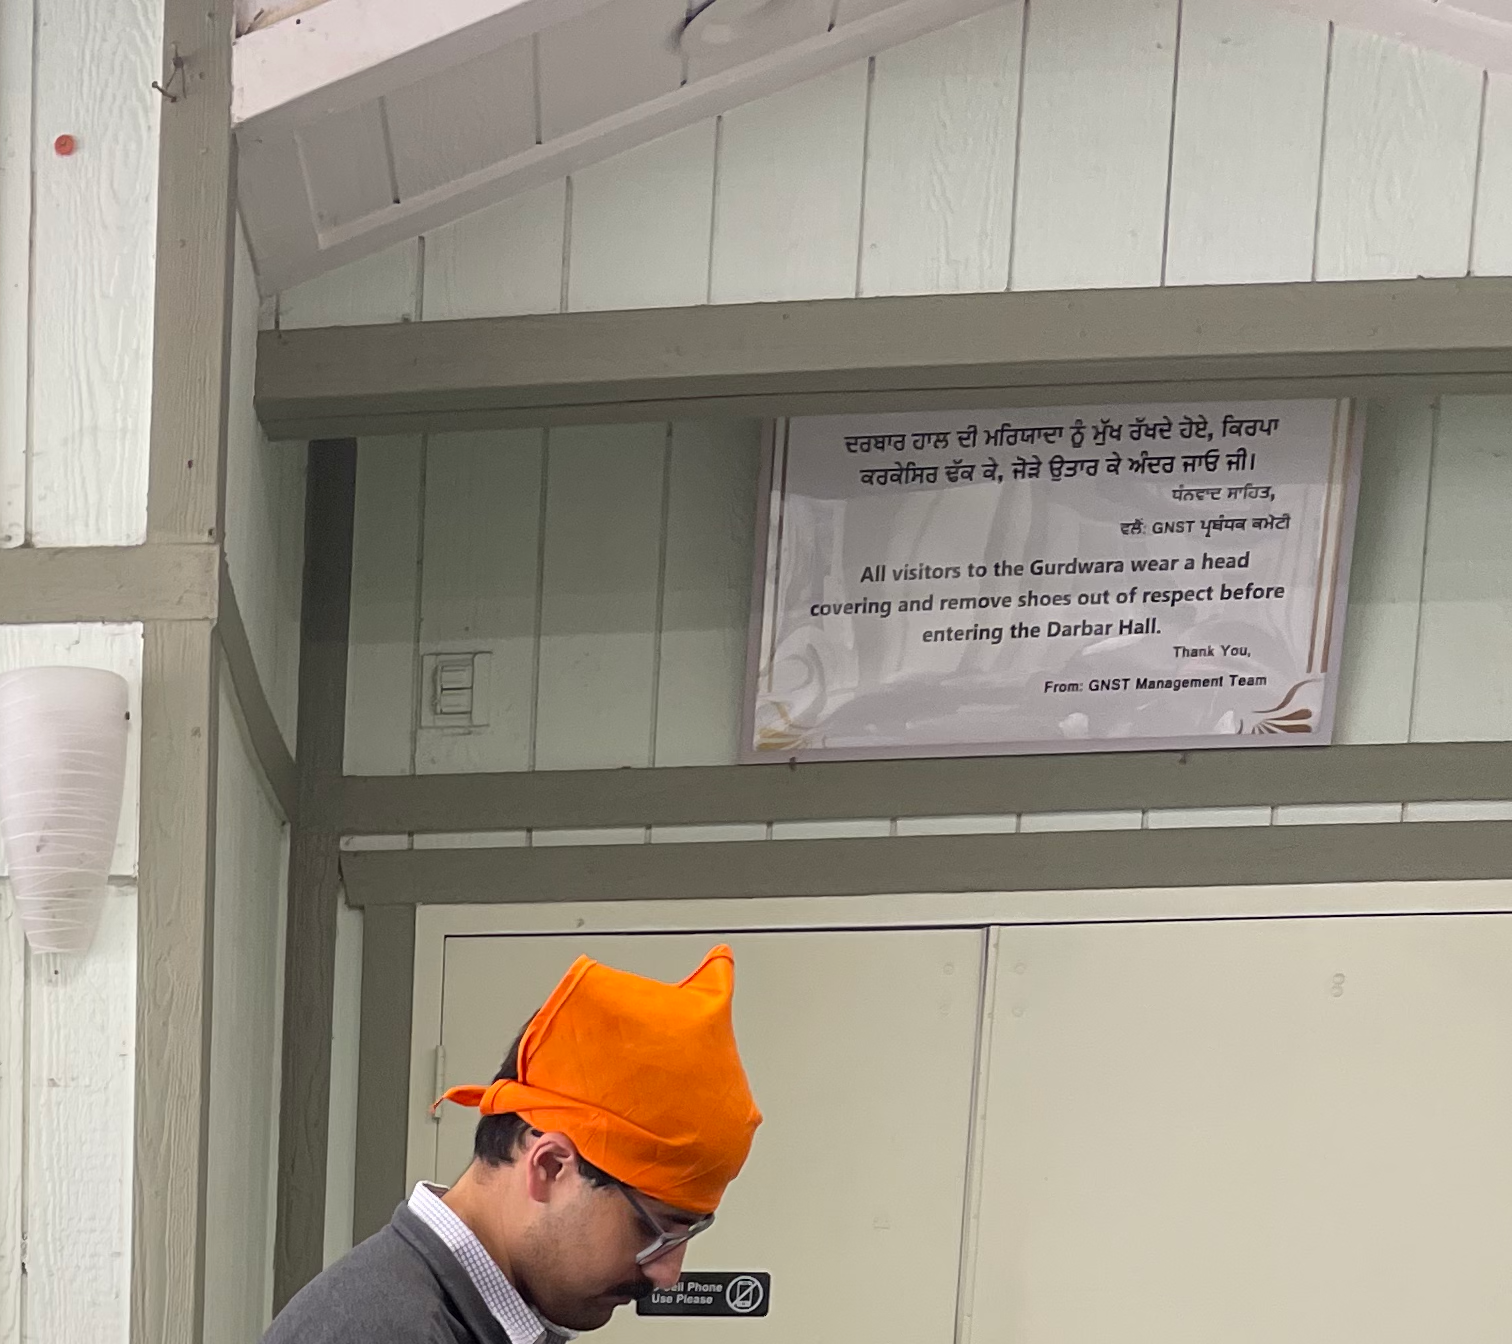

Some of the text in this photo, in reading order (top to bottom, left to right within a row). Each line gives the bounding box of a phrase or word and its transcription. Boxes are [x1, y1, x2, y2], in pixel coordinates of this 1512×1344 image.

[844, 434, 907, 453] ਦਰਬਾਰ
[911, 431, 954, 452] ਹਾਲ
[956, 425, 979, 448] ਦੀ
[1127, 416, 1173, 441] ਰੱਖਦੇ
[1221, 414, 1280, 437] ਕਿਰਪਾ
[944, 457, 978, 484] ਢੱਕ
[979, 457, 1005, 484] ਕੇ,
[1105, 451, 1124, 475] ਕੇ
[1126, 450, 1177, 476] ਅੰਦਰ
[1150, 518, 1196, 536] GNST
[860, 551, 1250, 583] All visitors to the Gurdwara wear a head
[810, 581, 1285, 618] covering and remove shoes out of respect before
[923, 616, 1161, 645] entering the Darbar Hall.
[1173, 645, 1251, 660] Thank You,
[1044, 673, 1267, 693] From: GNST Management Team
[651, 1293, 713, 1305] Use Please
[687, 1281, 723, 1293] Phone
